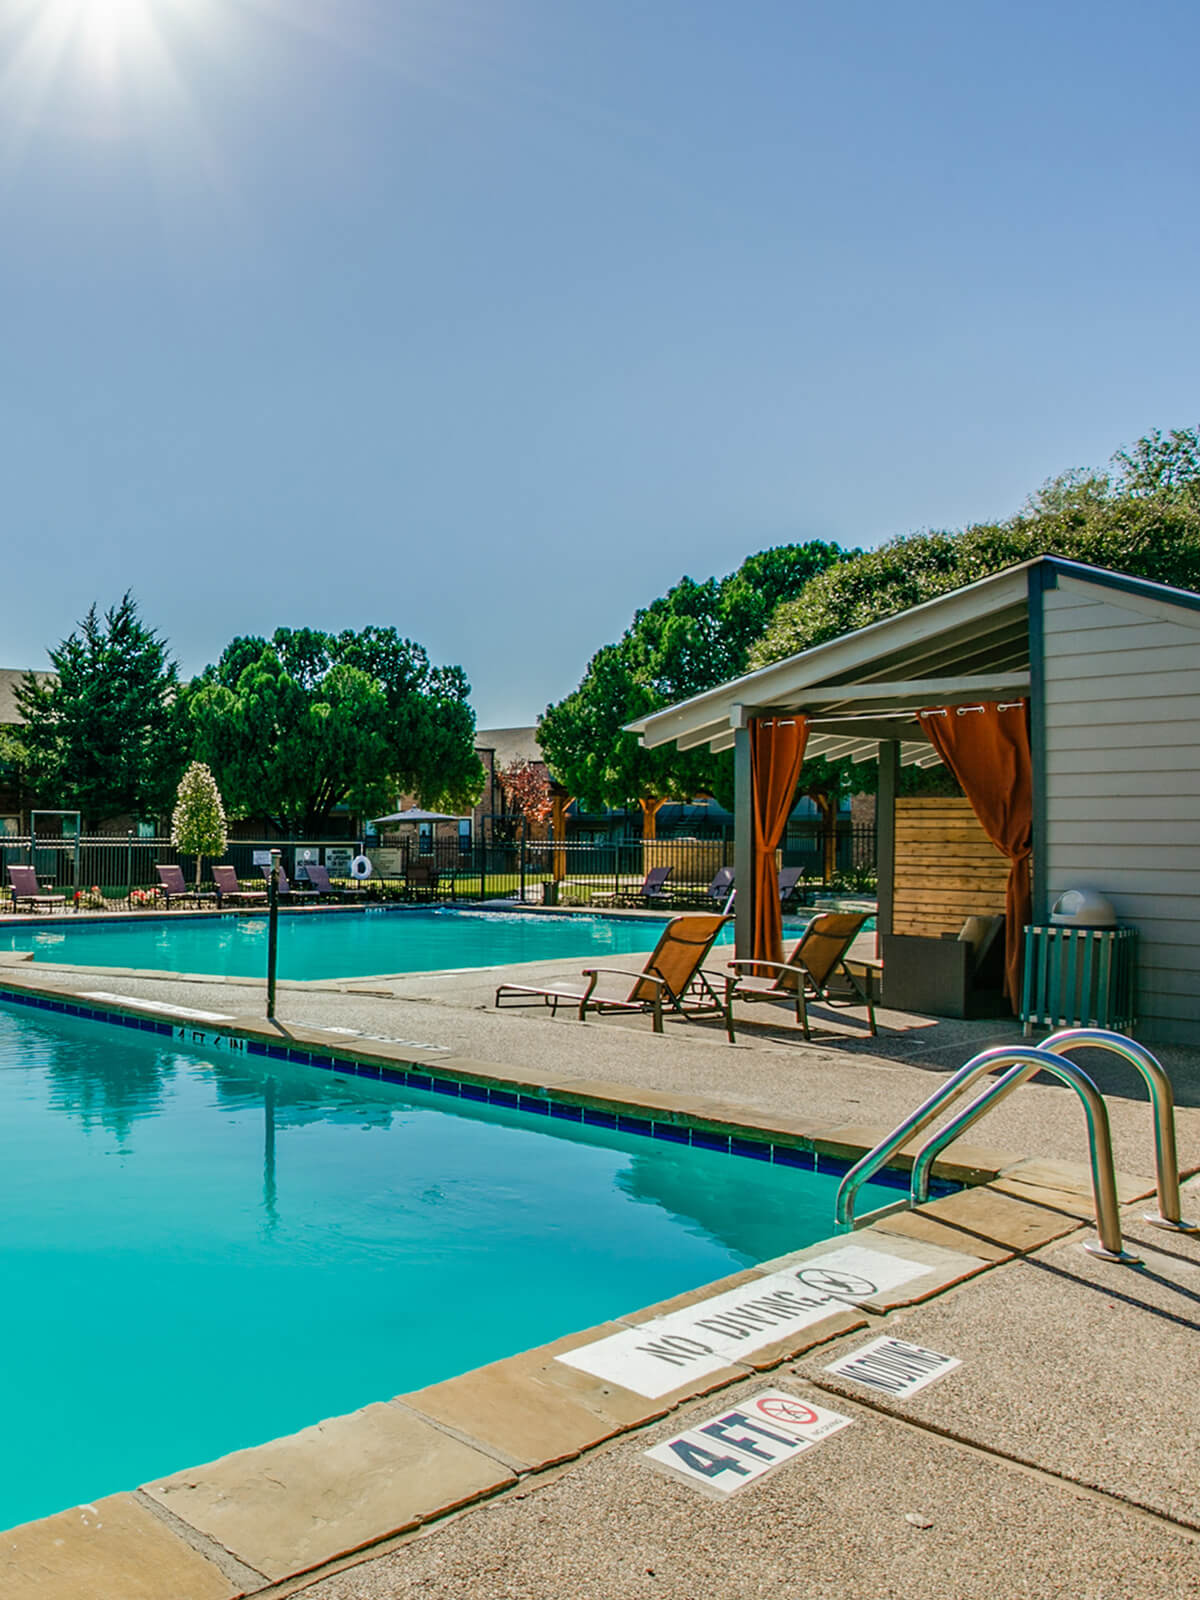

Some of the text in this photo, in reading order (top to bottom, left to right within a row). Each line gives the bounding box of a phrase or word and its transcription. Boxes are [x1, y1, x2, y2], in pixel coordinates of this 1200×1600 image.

[636, 1290, 827, 1366] NO DIVING
[668, 1438, 752, 1478] 4
